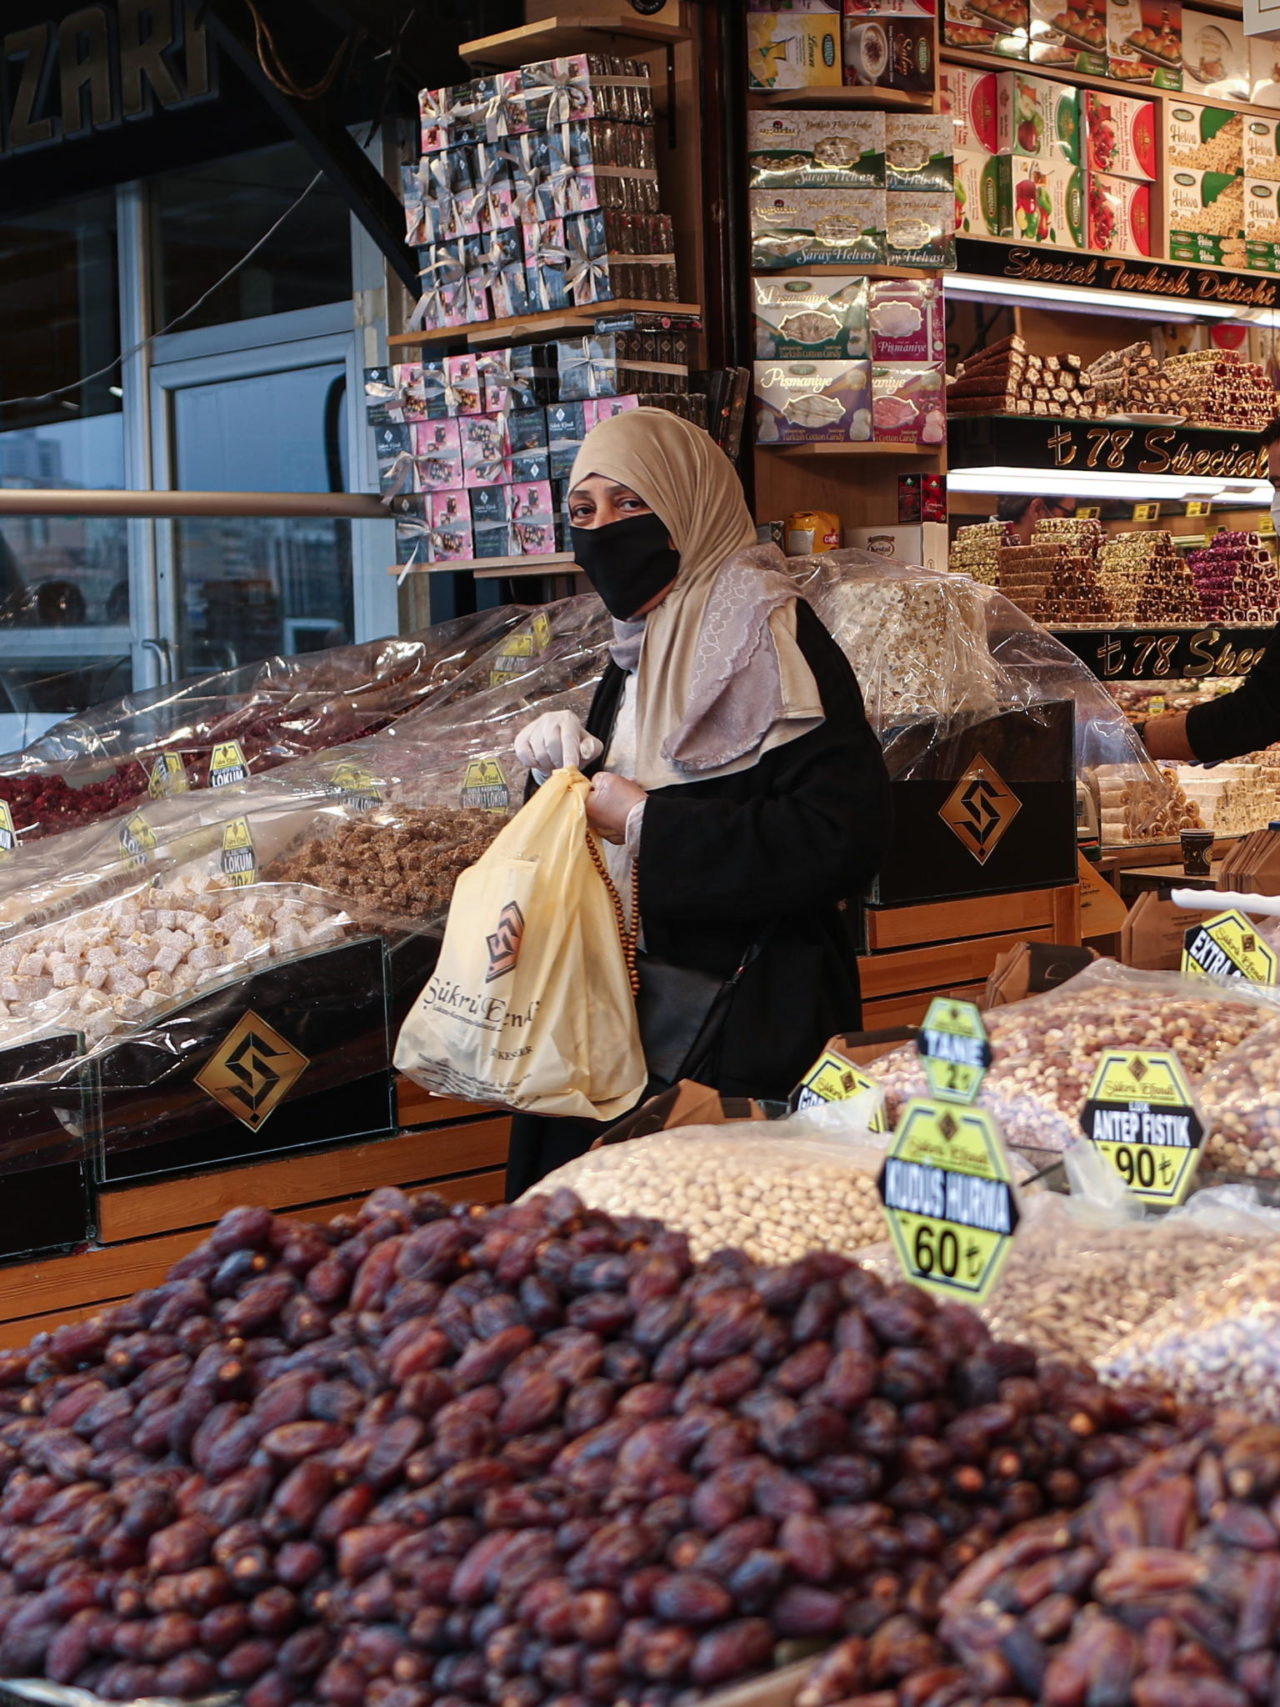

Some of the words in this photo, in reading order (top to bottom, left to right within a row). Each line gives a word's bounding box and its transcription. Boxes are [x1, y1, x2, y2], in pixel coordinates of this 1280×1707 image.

[796, 249, 830, 265] Saray
[1004, 247, 1097, 284] Special
[1104, 260, 1190, 295] Turkish
[1198, 271, 1277, 305] Delight
[212, 769, 244, 788] LOKUM
[224, 853, 254, 874] LOKUM
[1189, 929, 1232, 975] EXTRA
[925, 1028, 985, 1067] TANE
[1093, 1109, 1141, 1143] ANTEP
[1141, 1112, 1192, 1147] FISTIK
[945, 1171, 1012, 1236] HURMA
